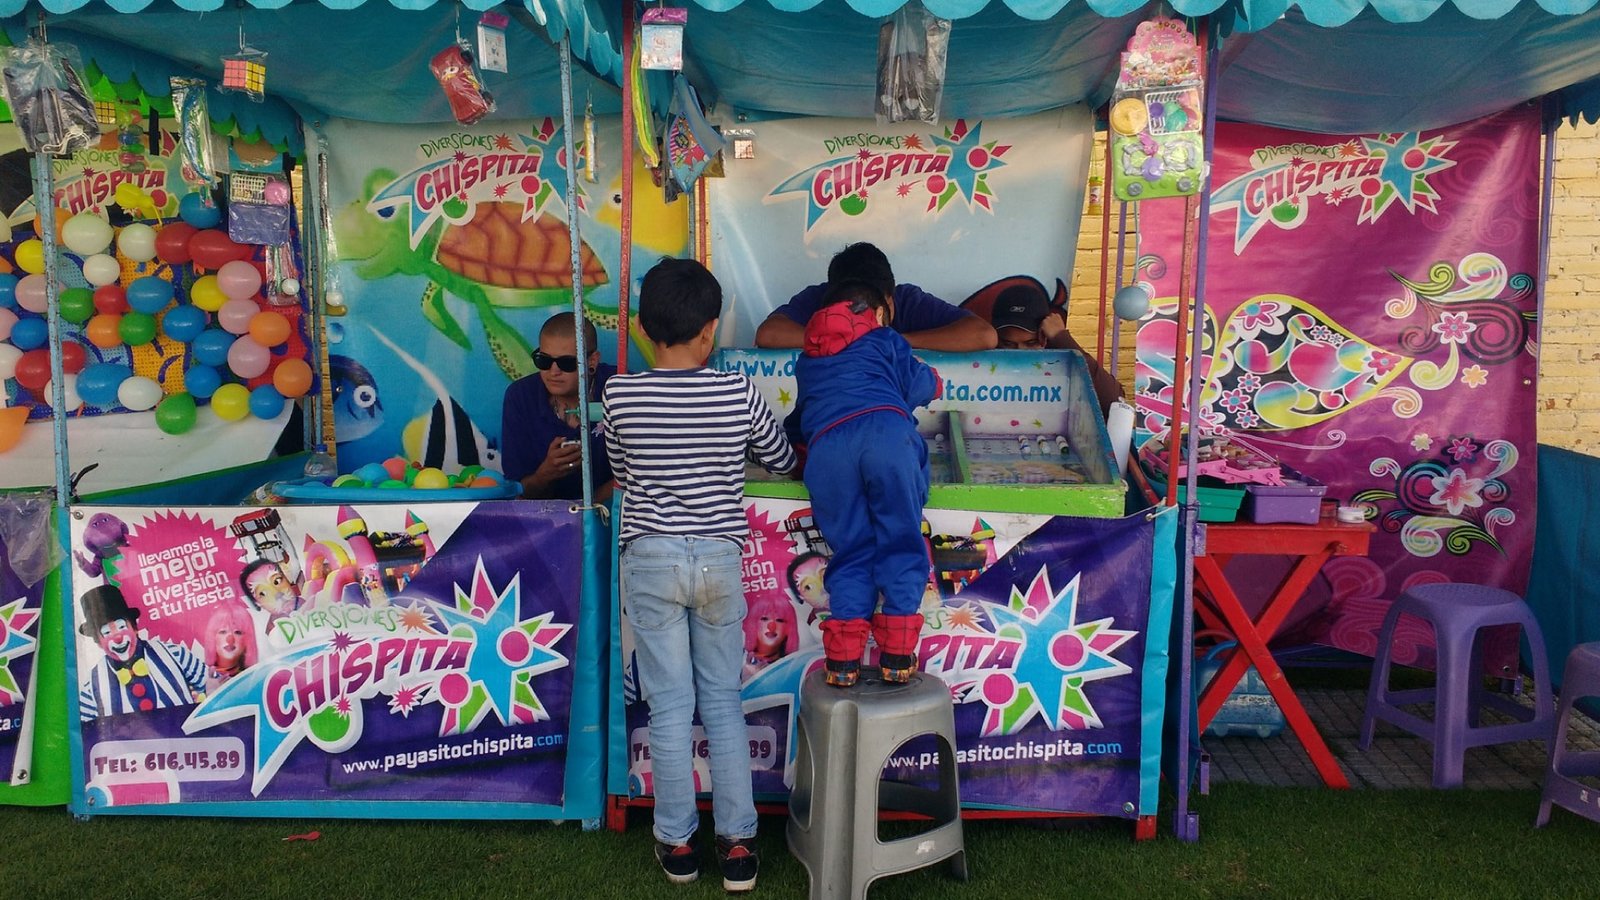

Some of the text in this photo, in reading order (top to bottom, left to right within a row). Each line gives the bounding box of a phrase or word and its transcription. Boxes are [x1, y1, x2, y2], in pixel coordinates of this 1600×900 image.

[725, 351, 1062, 402] www.d ta.com.mx
[138, 535, 215, 567] llevamos la
[140, 546, 219, 586] mejor
[142, 570, 229, 607] diversión
[148, 586, 235, 621] a tu fiesta
[266, 637, 473, 729] CHISPITA
[342, 733, 564, 774] www.payasitochispita.com
